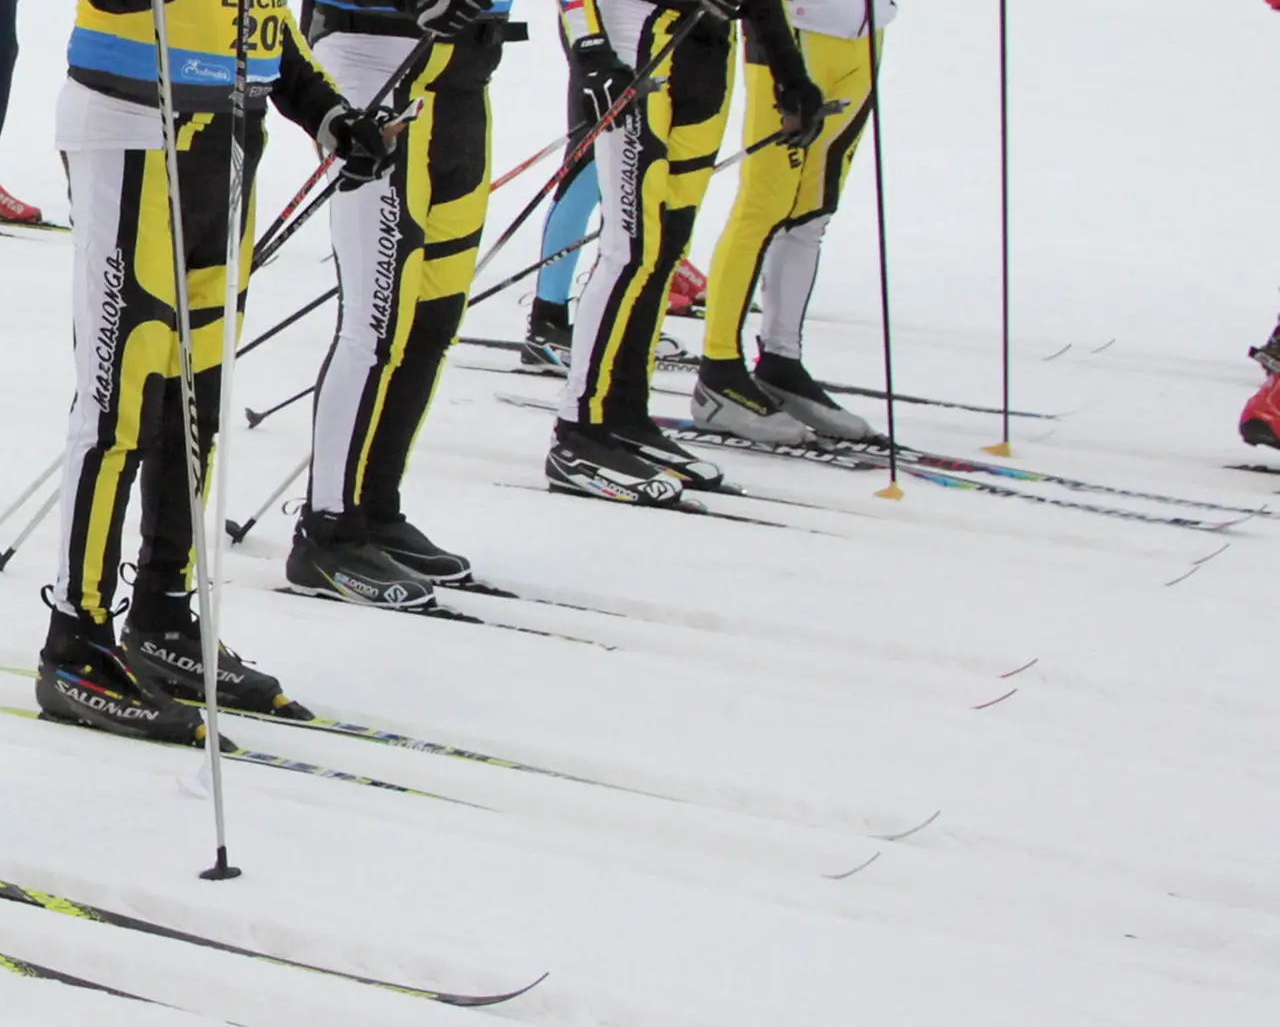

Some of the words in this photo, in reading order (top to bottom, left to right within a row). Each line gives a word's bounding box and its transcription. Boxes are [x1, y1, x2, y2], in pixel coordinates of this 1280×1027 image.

[372, 187, 401, 338] MARCIALONGA
[663, 429, 858, 469] MADSHUS
[54, 679, 160, 720] SALOMON
